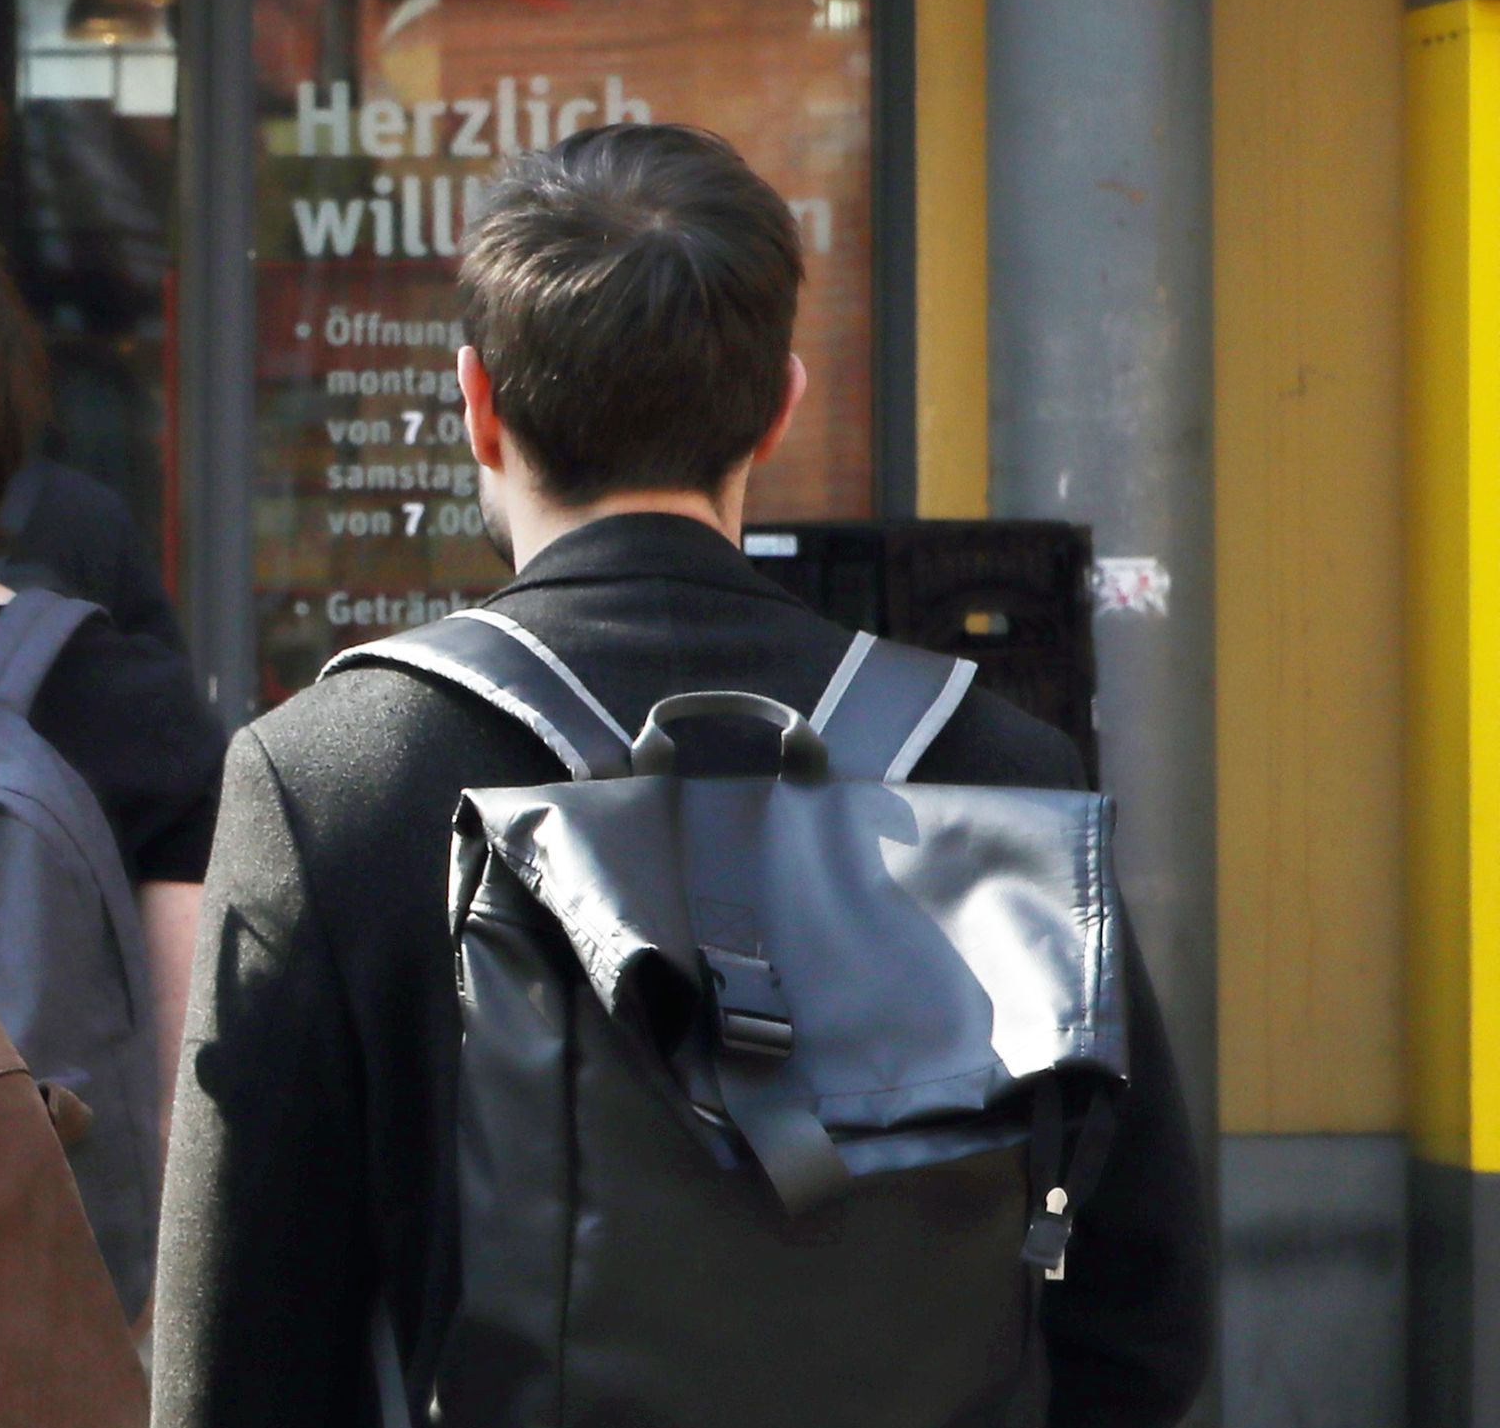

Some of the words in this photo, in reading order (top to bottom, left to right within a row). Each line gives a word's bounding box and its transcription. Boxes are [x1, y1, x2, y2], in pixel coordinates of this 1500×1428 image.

[325, 306, 464, 352] Öffnung
[326, 419, 392, 445] von
[400, 410, 469, 446] 7.0
[326, 510, 393, 536] von
[326, 589, 461, 626] Geträn
